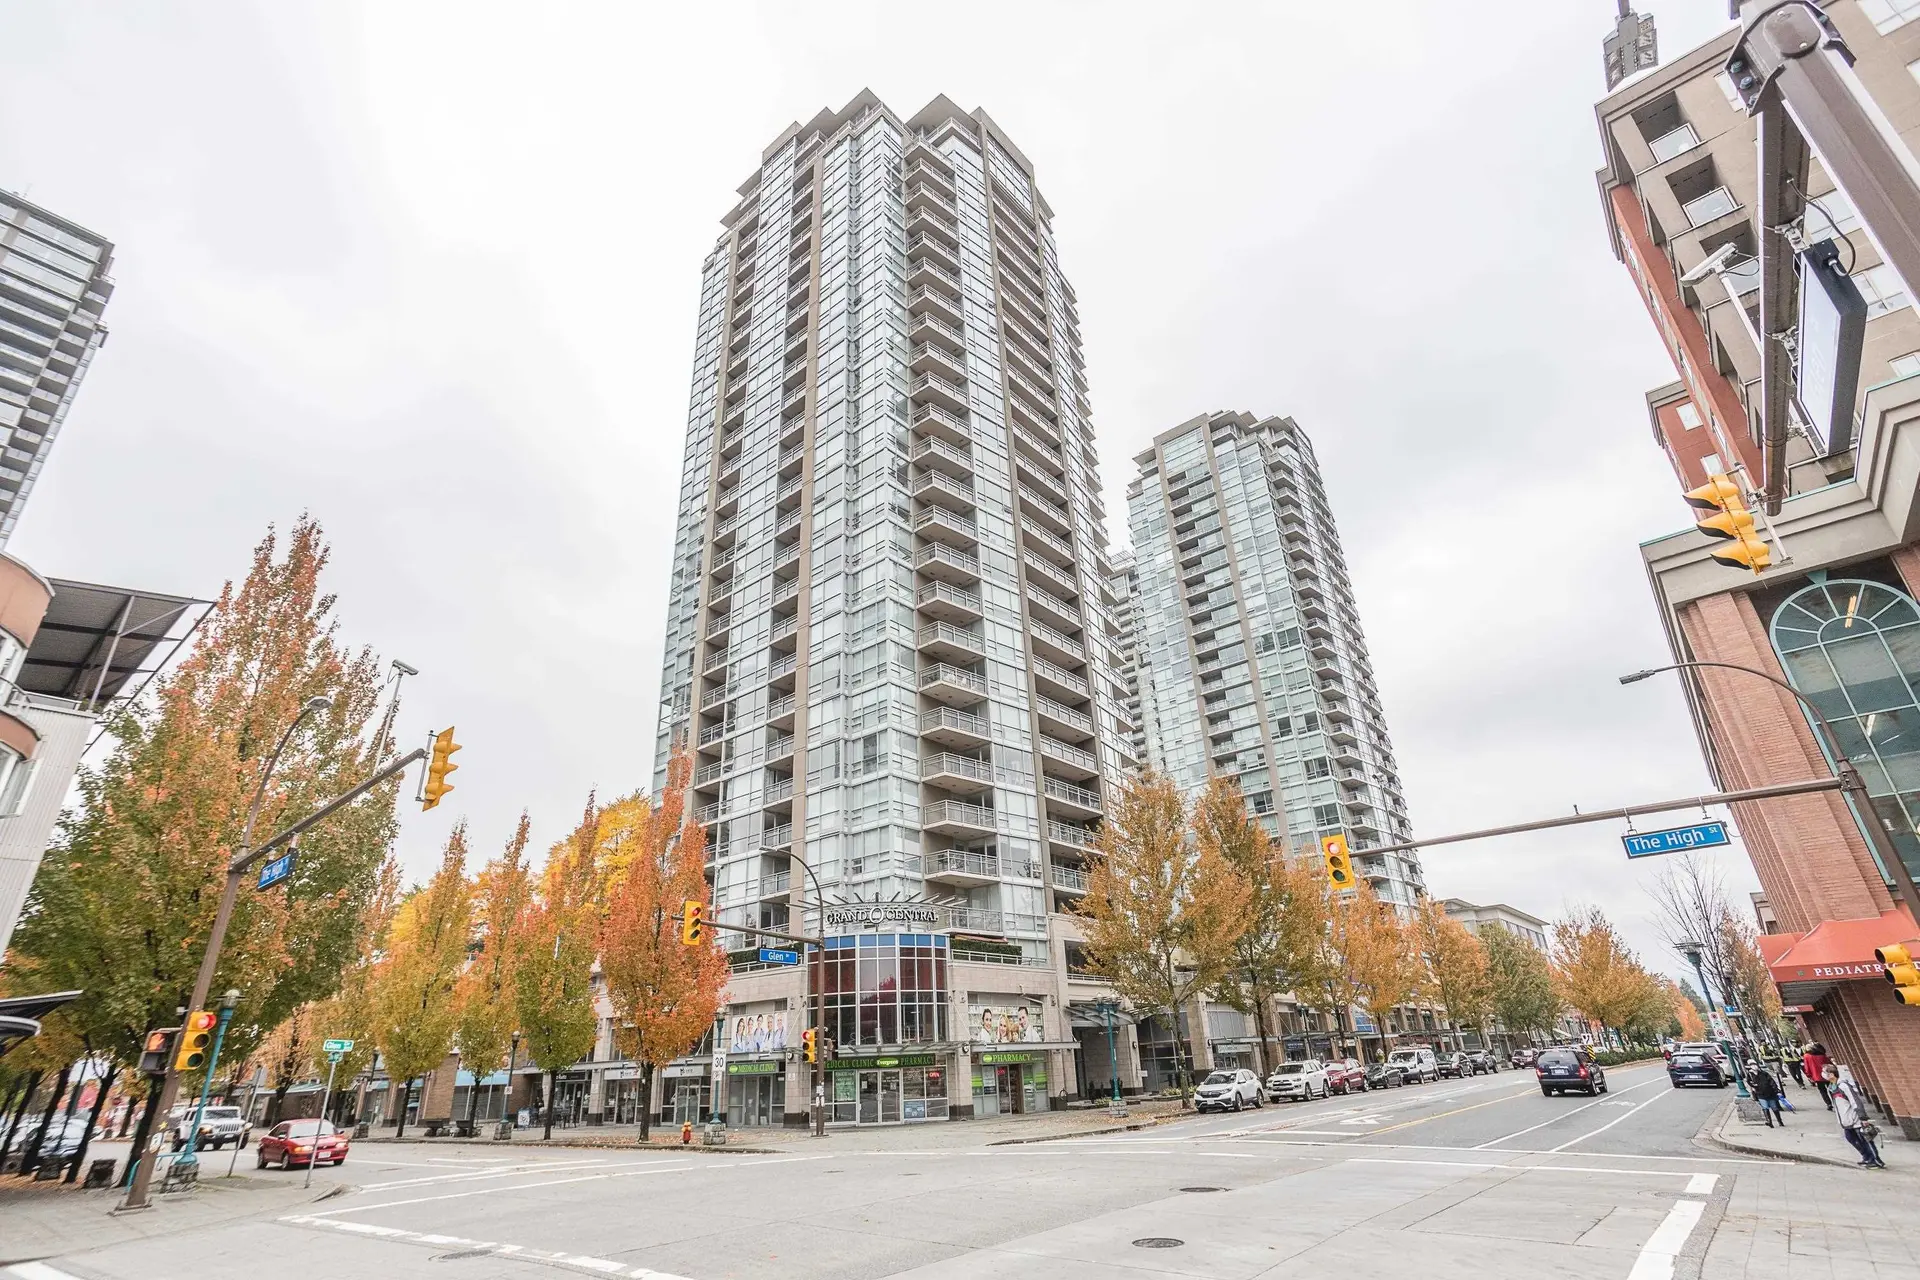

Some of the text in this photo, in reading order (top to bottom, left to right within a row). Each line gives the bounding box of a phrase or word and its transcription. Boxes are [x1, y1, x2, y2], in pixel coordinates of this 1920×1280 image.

[1630, 826, 1718, 851] The High St
[827, 909, 939, 925] GRAND CENTRAL
[768, 952, 784, 961] Glen
[714, 1057, 724, 1068] 30
[852, 1058, 874, 1068] CLINIC
[992, 1053, 1032, 1063] PHARMACY
